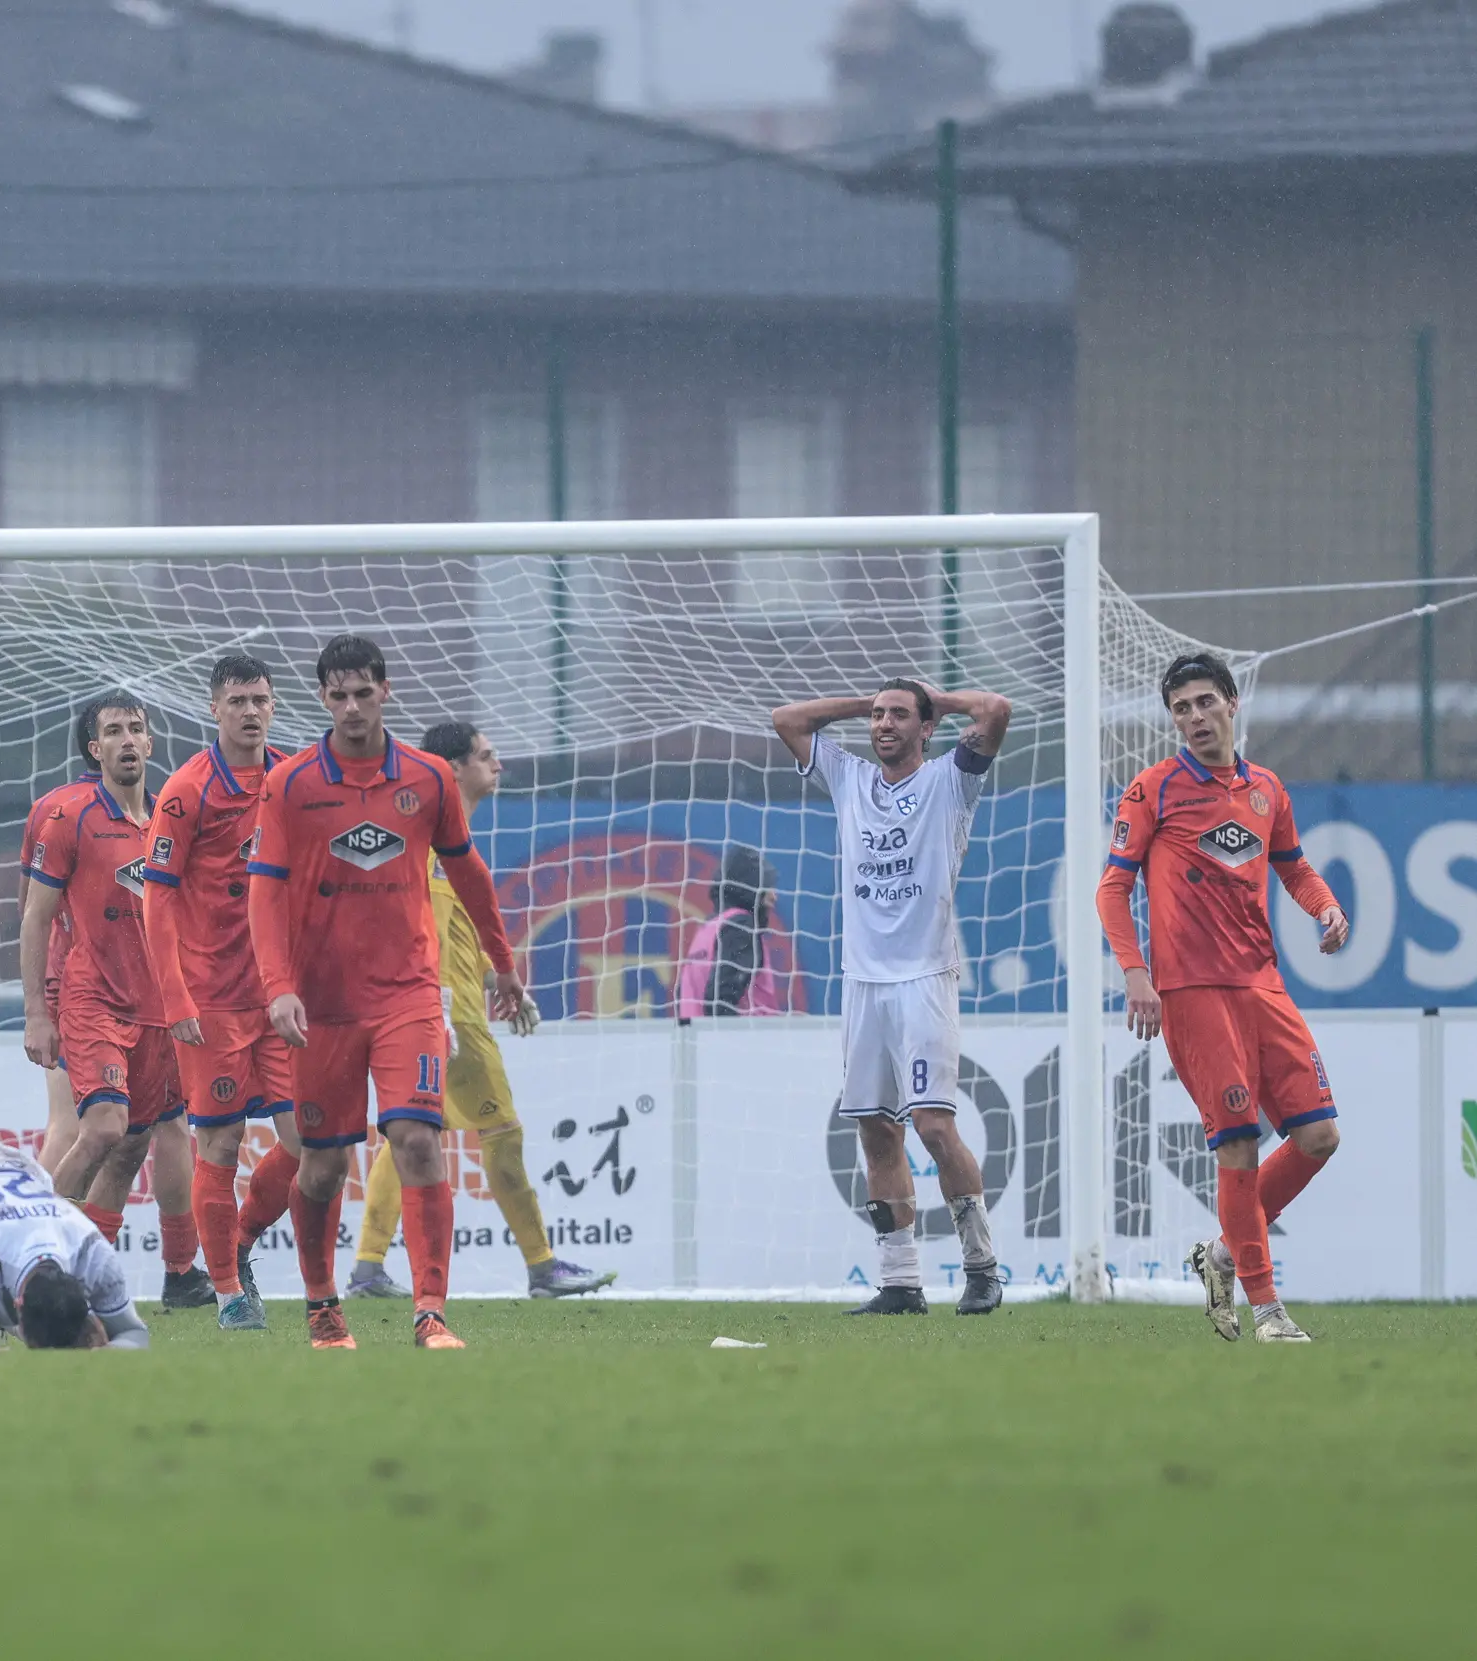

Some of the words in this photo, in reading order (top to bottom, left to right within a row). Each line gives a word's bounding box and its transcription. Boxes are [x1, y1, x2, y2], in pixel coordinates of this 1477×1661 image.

[348, 828, 387, 850] NSF
[1215, 827, 1249, 848] NSF
[130, 862, 146, 880] NS
[875, 883, 923, 901] Marsh
[416, 1053, 441, 1095] 11
[912, 1058, 928, 1094] 8
